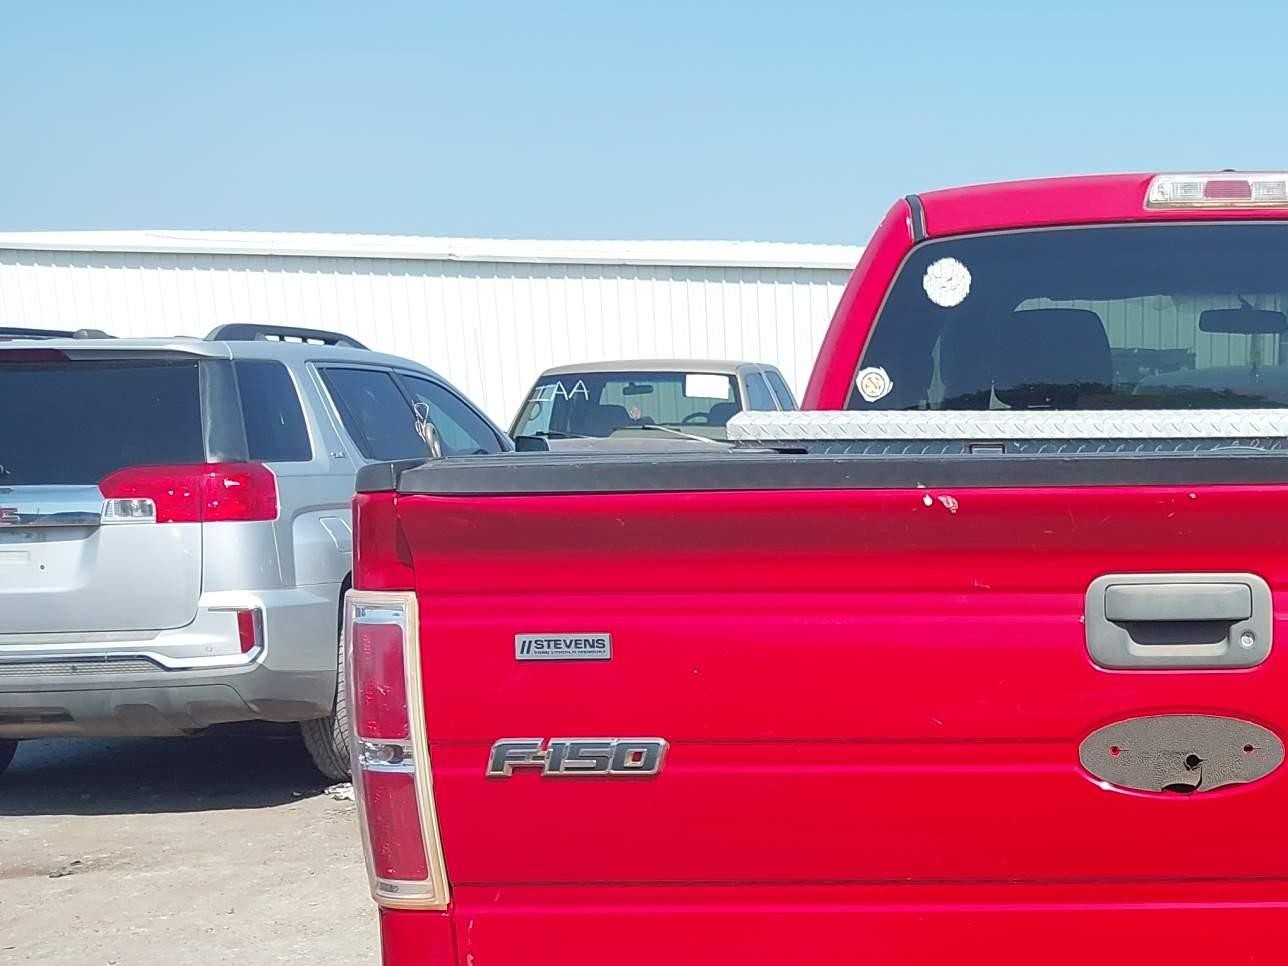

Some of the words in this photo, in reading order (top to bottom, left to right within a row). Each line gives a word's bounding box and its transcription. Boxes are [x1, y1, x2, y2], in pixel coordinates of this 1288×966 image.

[528, 380, 590, 402] IAA
[534, 638, 606, 650] STEVENS
[485, 737, 670, 778] F-150
